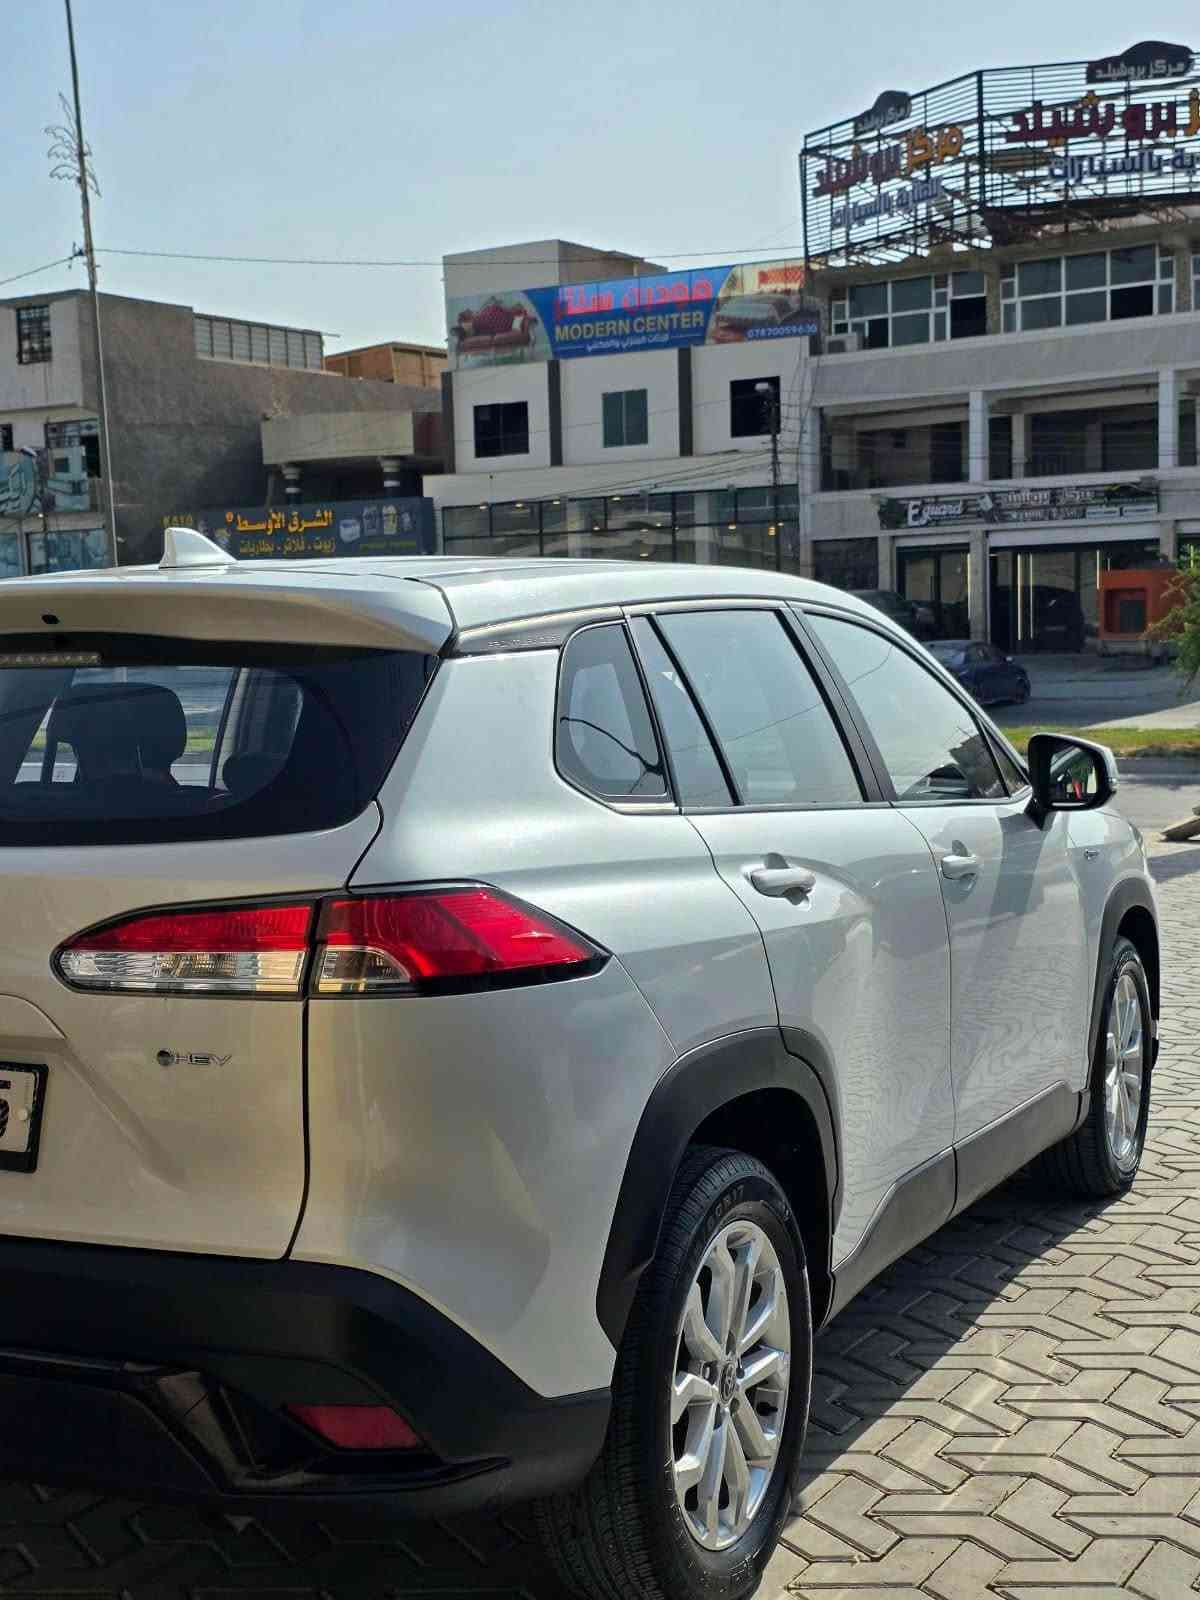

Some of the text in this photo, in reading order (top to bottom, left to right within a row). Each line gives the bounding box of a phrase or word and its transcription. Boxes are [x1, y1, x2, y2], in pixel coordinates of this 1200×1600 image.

[1149, 59, 1185, 77] مركز
[903, 126, 963, 174] مركز
[1050, 149, 1161, 186] بالسيارات
[554, 277, 713, 320] مودرن سنتر
[555, 318, 630, 342] MODERN
[633, 310, 704, 334] CENTER
[237, 508, 332, 535] الشرق الأوسط
[173, 1052, 232, 1066] HEV
